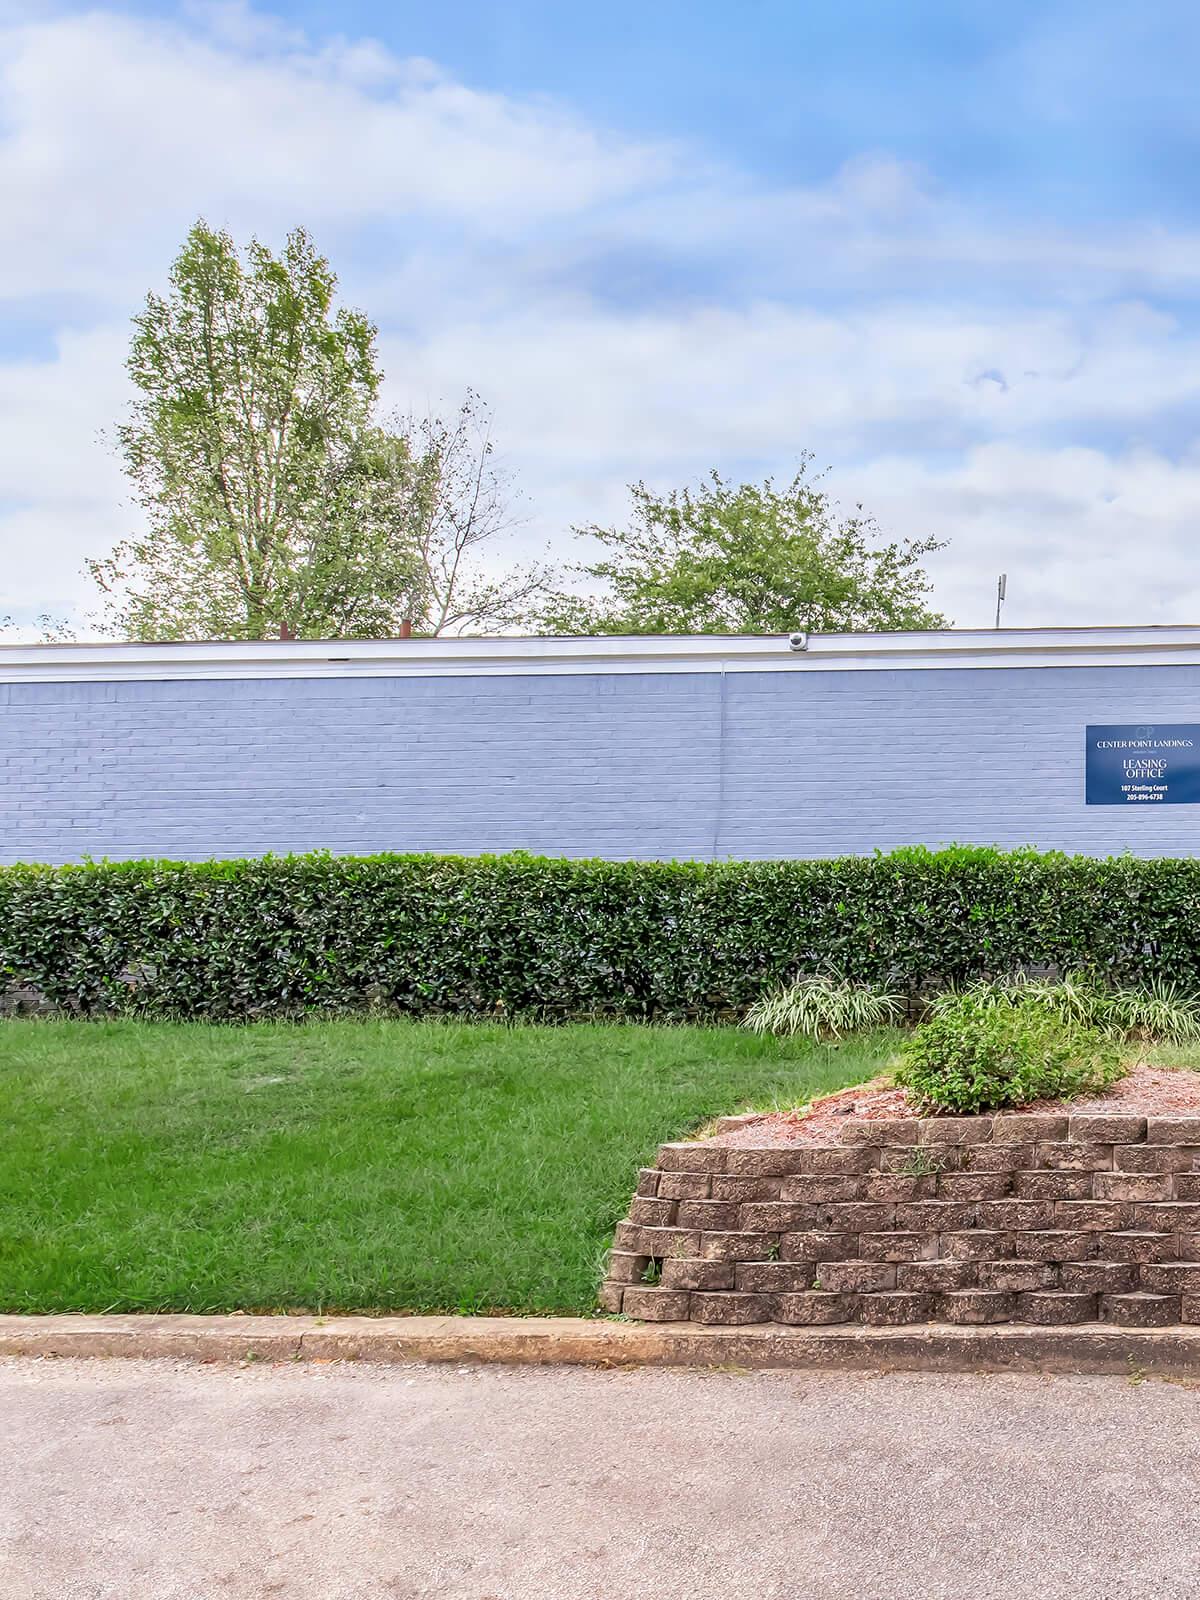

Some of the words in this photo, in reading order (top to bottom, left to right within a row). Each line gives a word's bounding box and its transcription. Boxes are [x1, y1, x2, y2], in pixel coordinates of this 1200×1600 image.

[1128, 740, 1152, 748] POINT
[1123, 759, 1167, 769] LEASING
[1126, 769, 1164, 778] OFFICE
